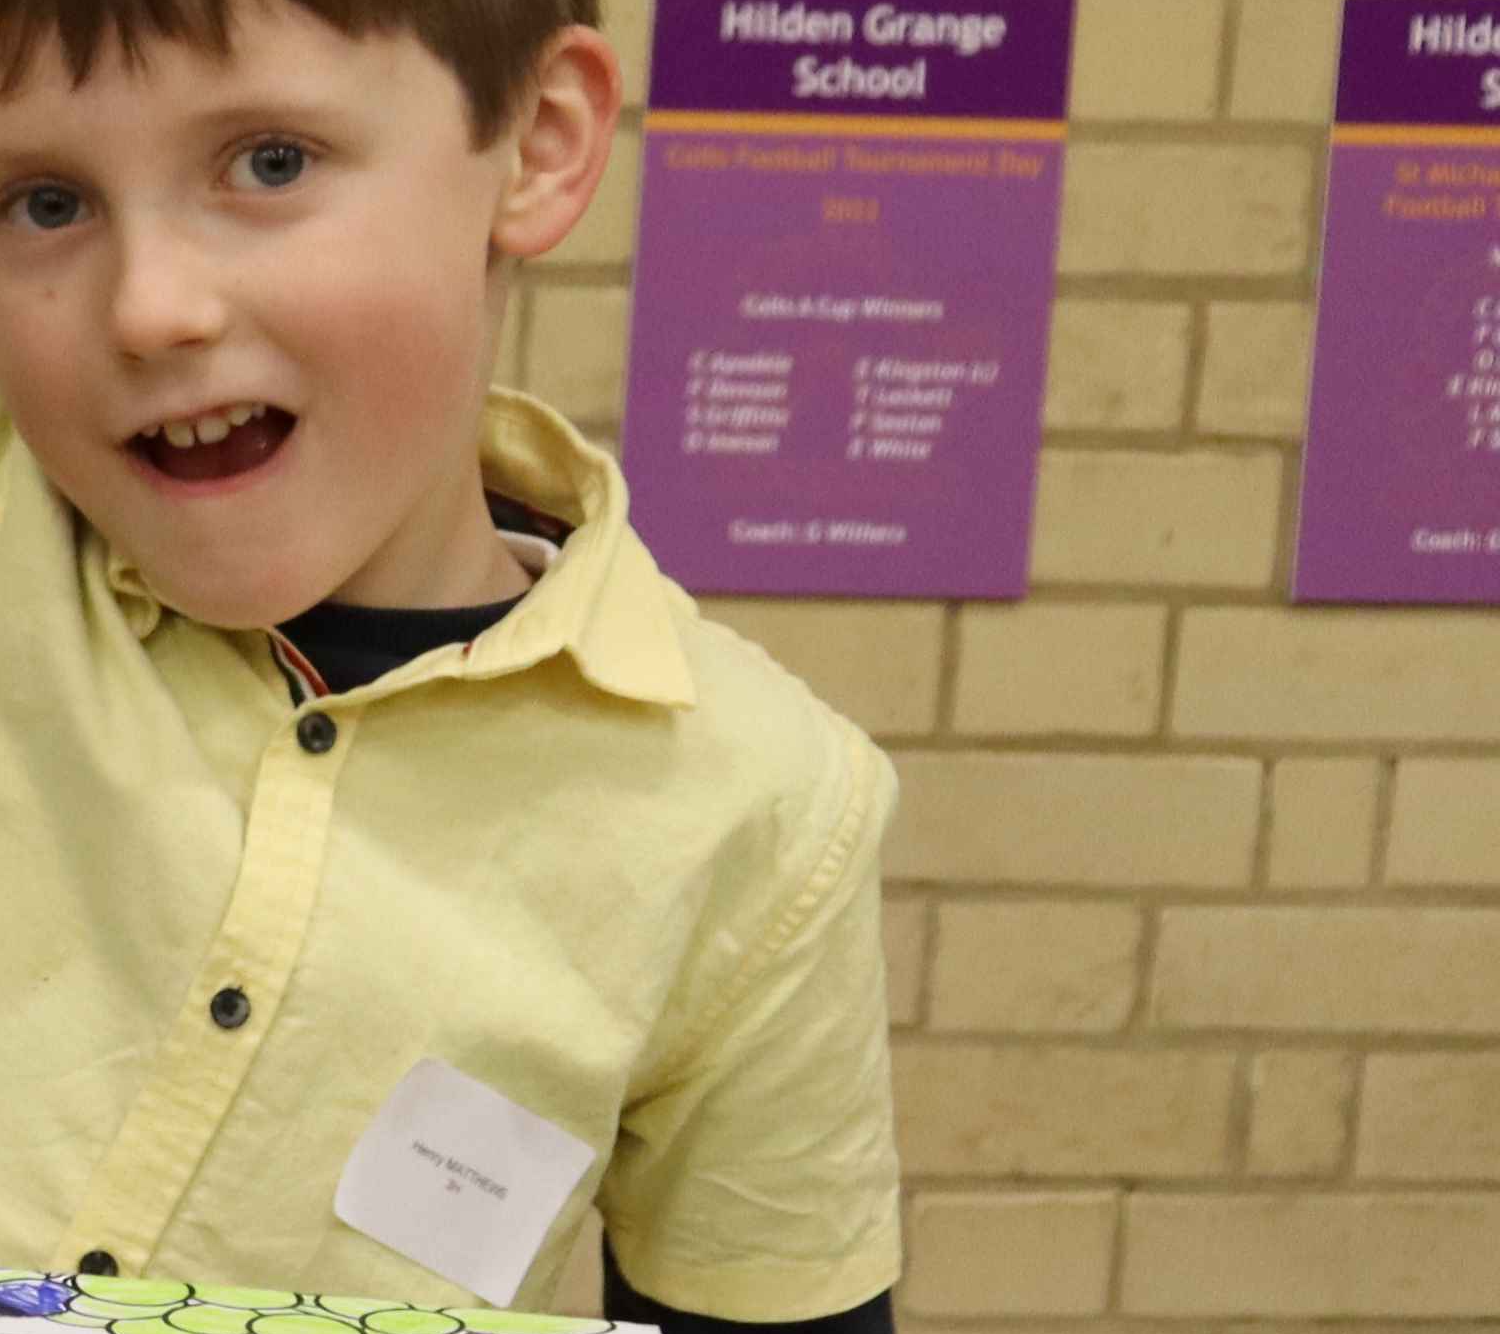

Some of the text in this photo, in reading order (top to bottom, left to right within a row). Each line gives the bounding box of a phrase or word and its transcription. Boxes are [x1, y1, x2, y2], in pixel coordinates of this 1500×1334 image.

[721, 2, 1007, 56] Hilden Grange
[793, 58, 926, 99] School
